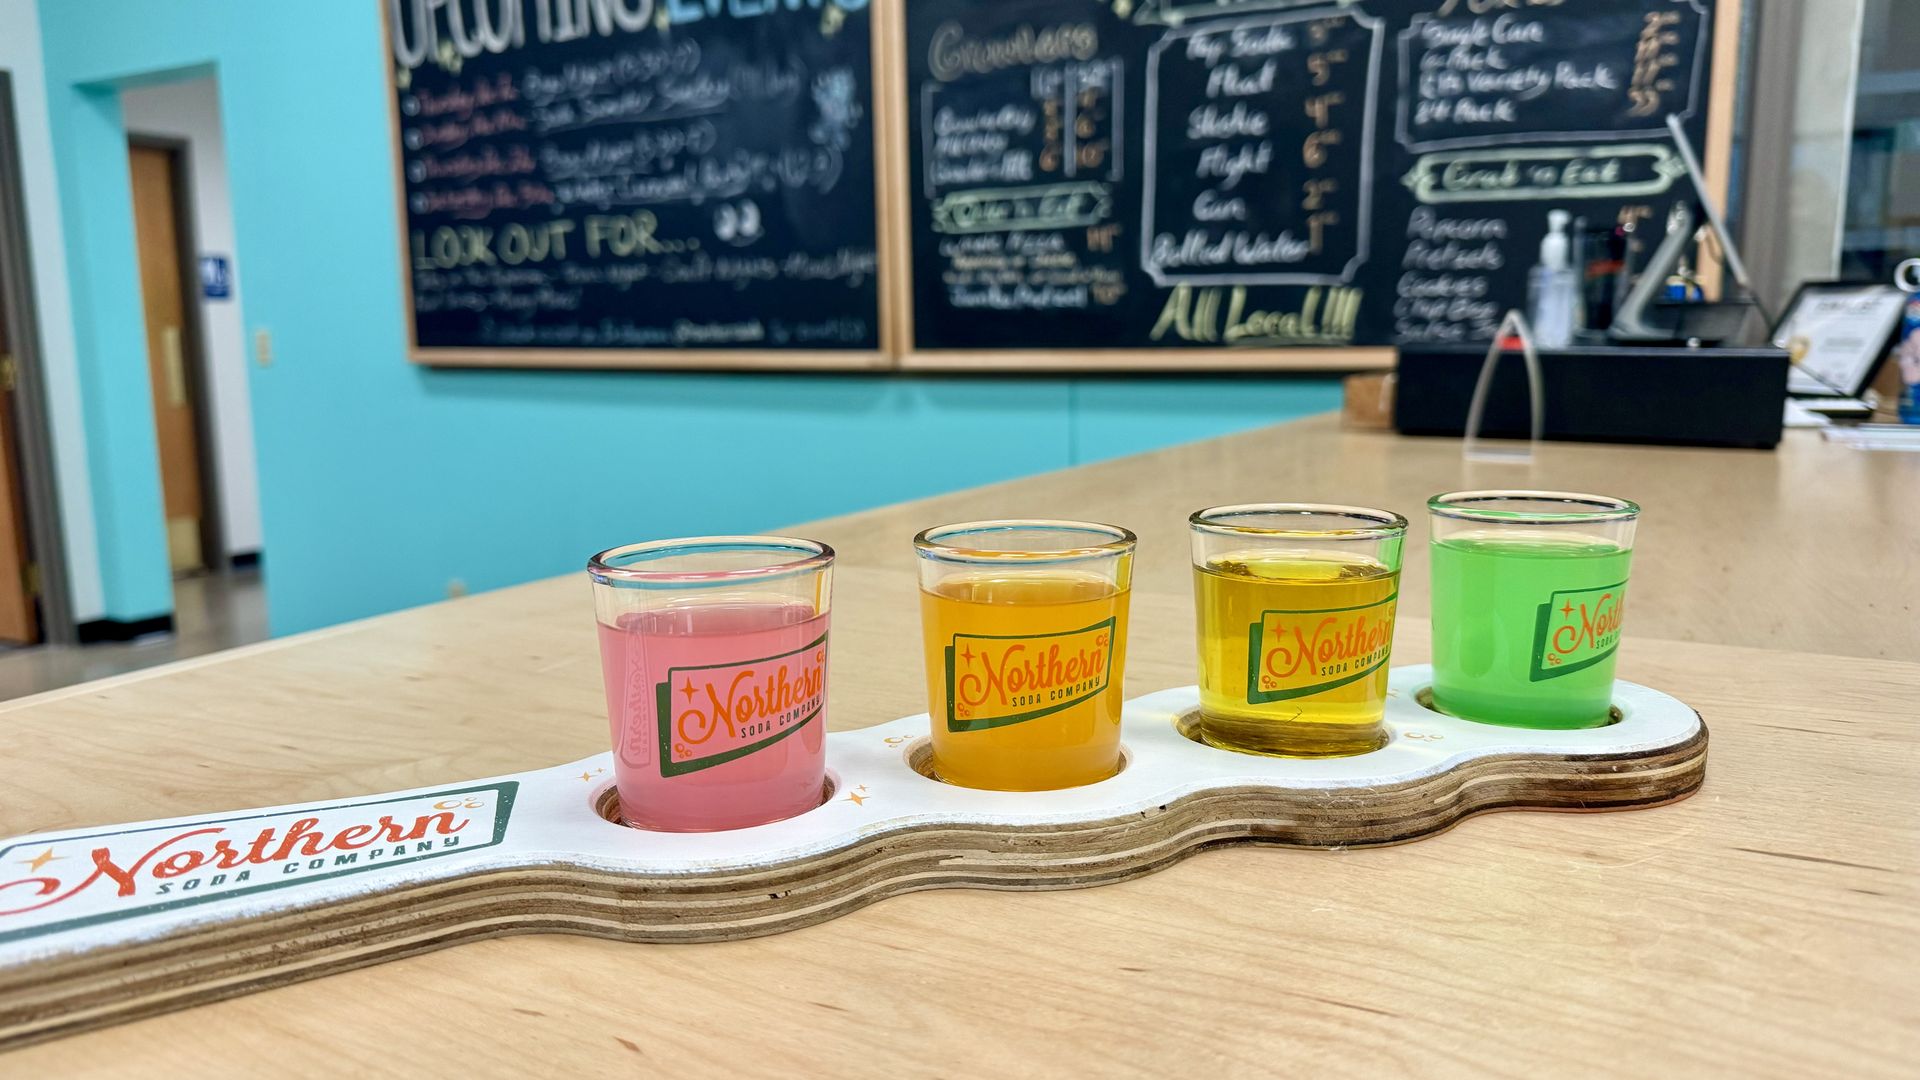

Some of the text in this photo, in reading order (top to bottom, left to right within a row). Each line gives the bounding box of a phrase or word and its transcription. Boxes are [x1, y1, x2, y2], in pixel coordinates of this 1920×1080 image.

[928, 21, 1099, 82] Growlers
[1491, 12, 1544, 44] Can
[1554, 60, 1619, 90] Pack
[1562, 157, 1620, 186] Eat
[1192, 188, 1247, 222] Can
[414, 224, 498, 270] LOOK
[500, 218, 576, 266] OUT
[1149, 281, 1222, 342] All
[1266, 615, 1392, 678] Northern
[1321, 662, 1348, 676] SODA
[959, 644, 1105, 706] Northern
[1012, 675, 1101, 707] SODA COMPANY
[678, 665, 822, 745] Northern
[741, 720, 770, 738] SODA
[0, 812, 470, 916] Northern
[155, 835, 460, 895] SODA COMPANY
